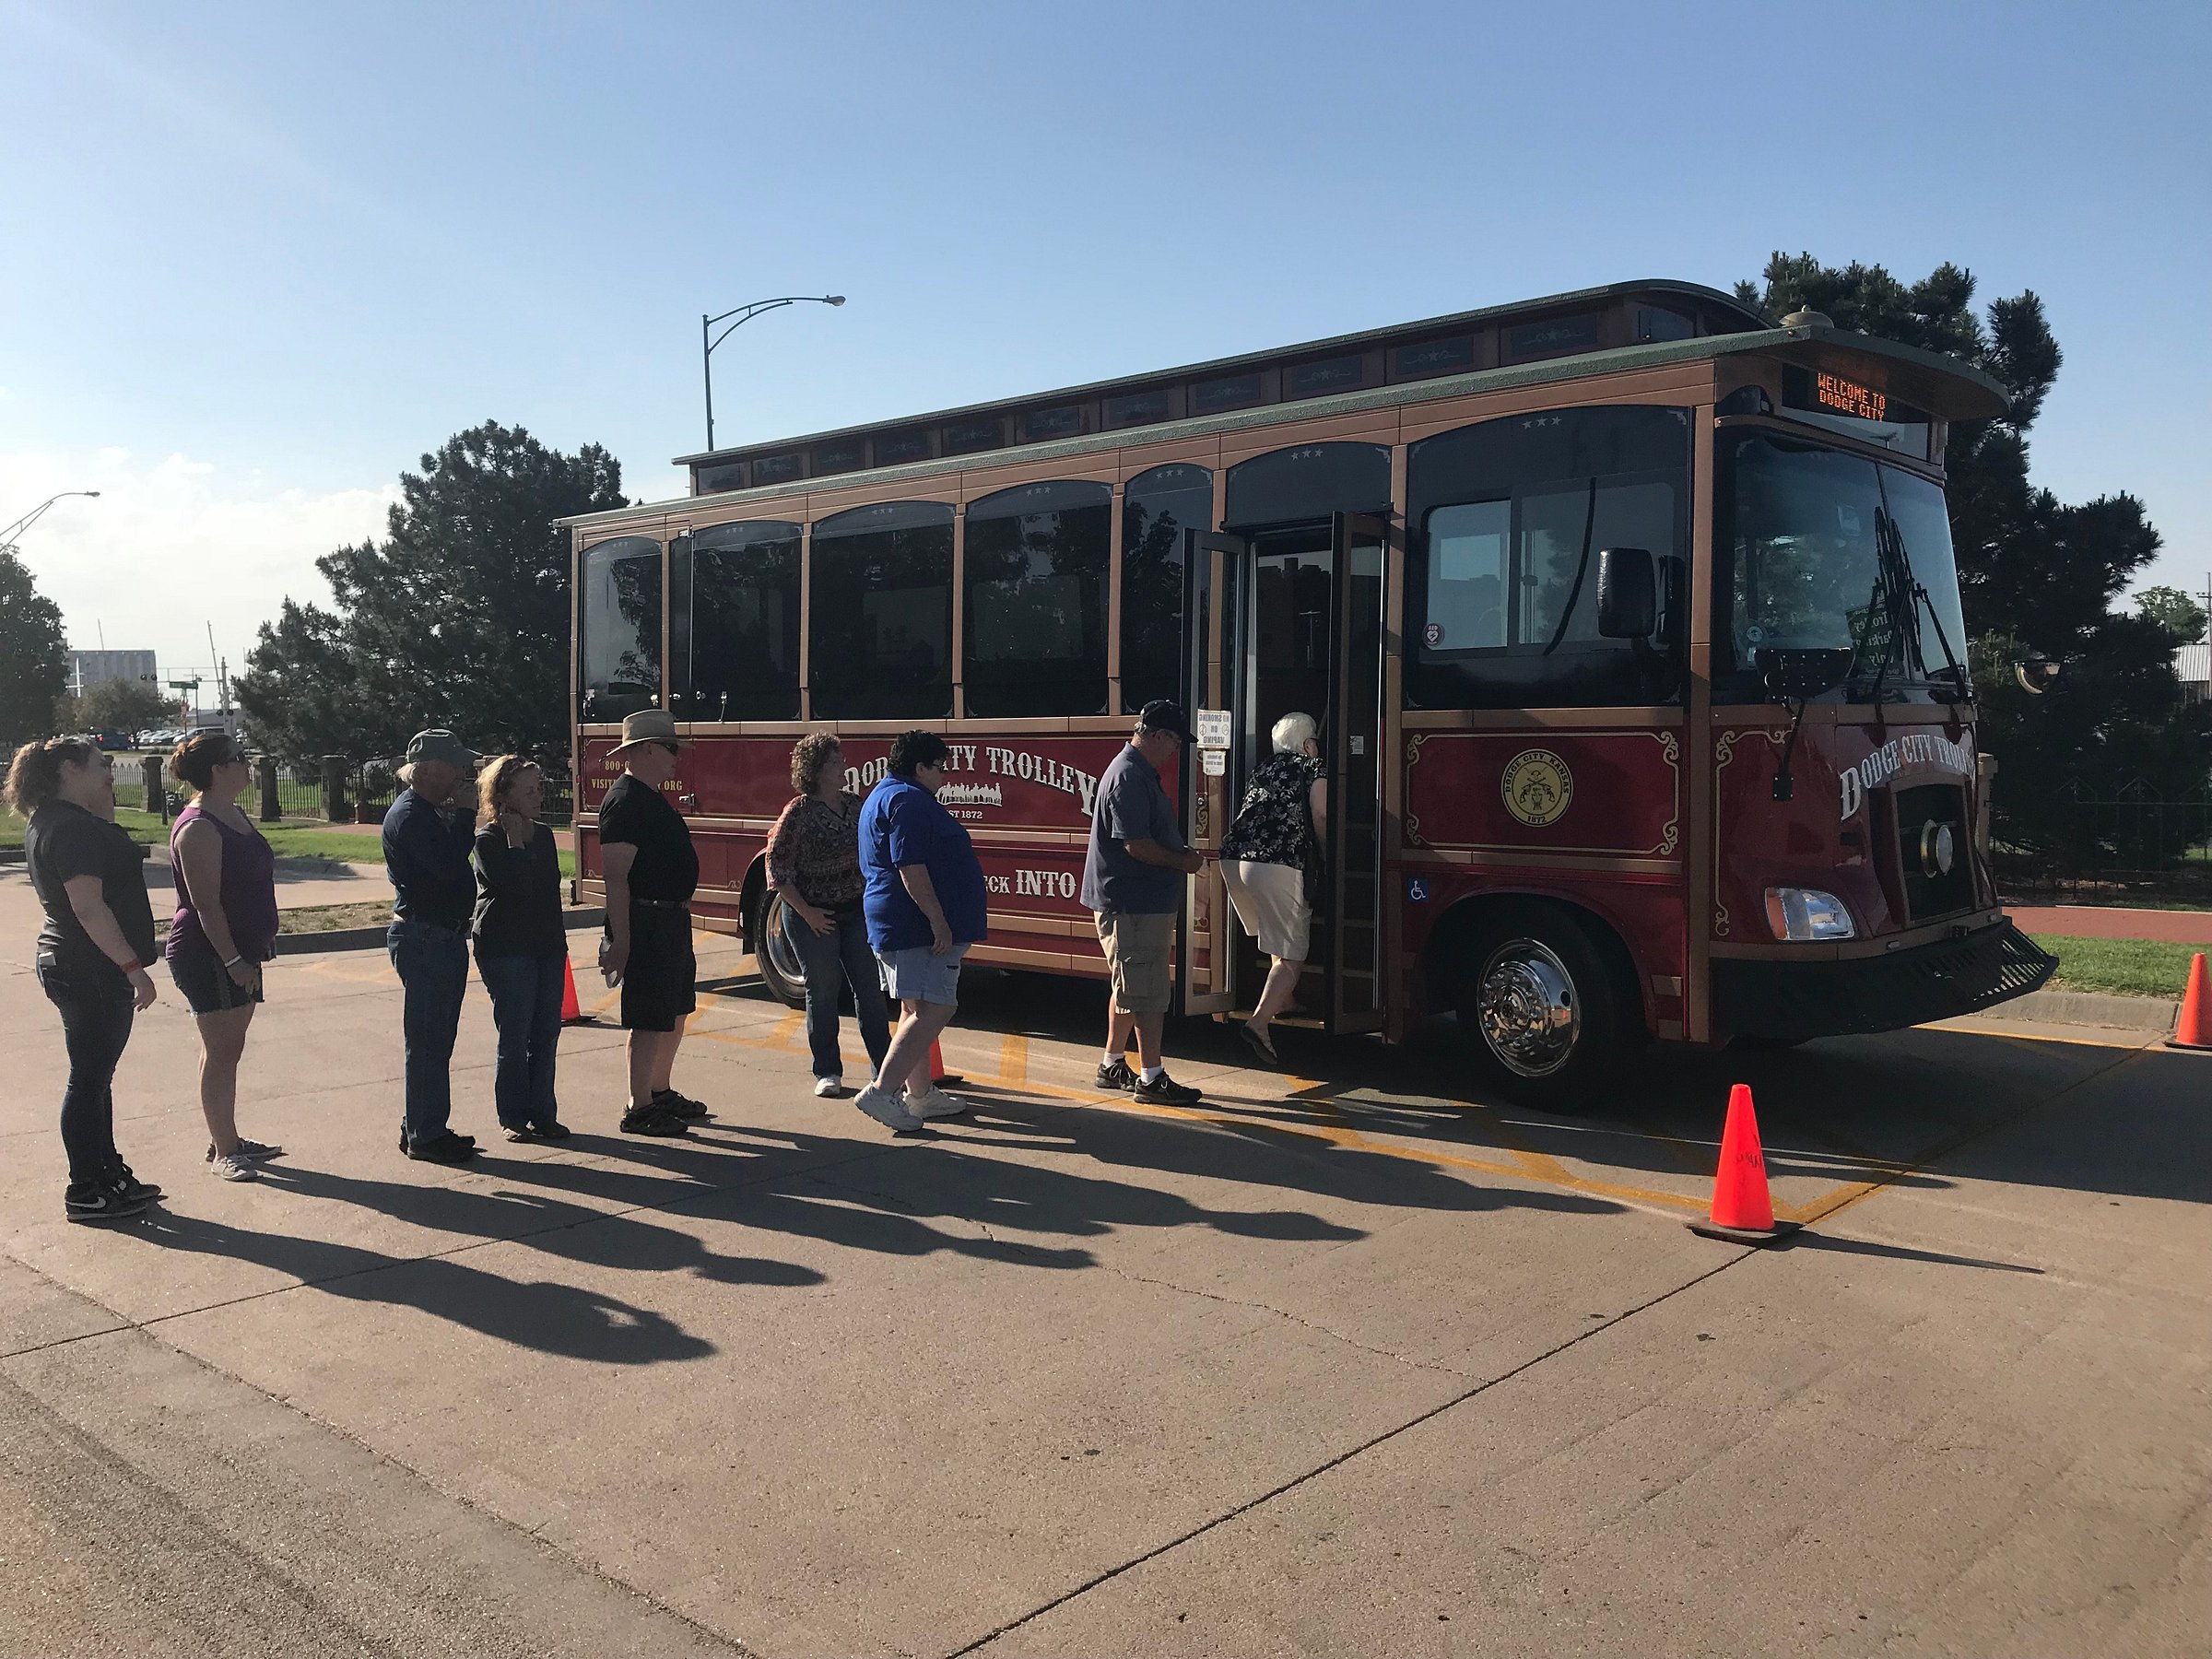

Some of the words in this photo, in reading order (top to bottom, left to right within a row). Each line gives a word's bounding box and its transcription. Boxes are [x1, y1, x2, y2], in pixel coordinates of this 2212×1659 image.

[1818, 372, 1869, 405] WELCOME
[1872, 393, 1886, 410] TO
[1819, 389, 1854, 413] DODGE
[1859, 404, 1885, 422] CITY
[942, 745, 977, 771] TY
[985, 747, 1098, 818] TROLLEY
[1505, 760, 1522, 793] DODGE
[1523, 753, 1545, 762] CITY
[1549, 757, 1570, 794] KANSAS
[1839, 739, 1901, 822] DODGE
[1901, 735, 1934, 764] CITY
[947, 809, 960, 818] ST
[961, 810, 983, 819] 1872
[1015, 869, 1077, 899] INTO
